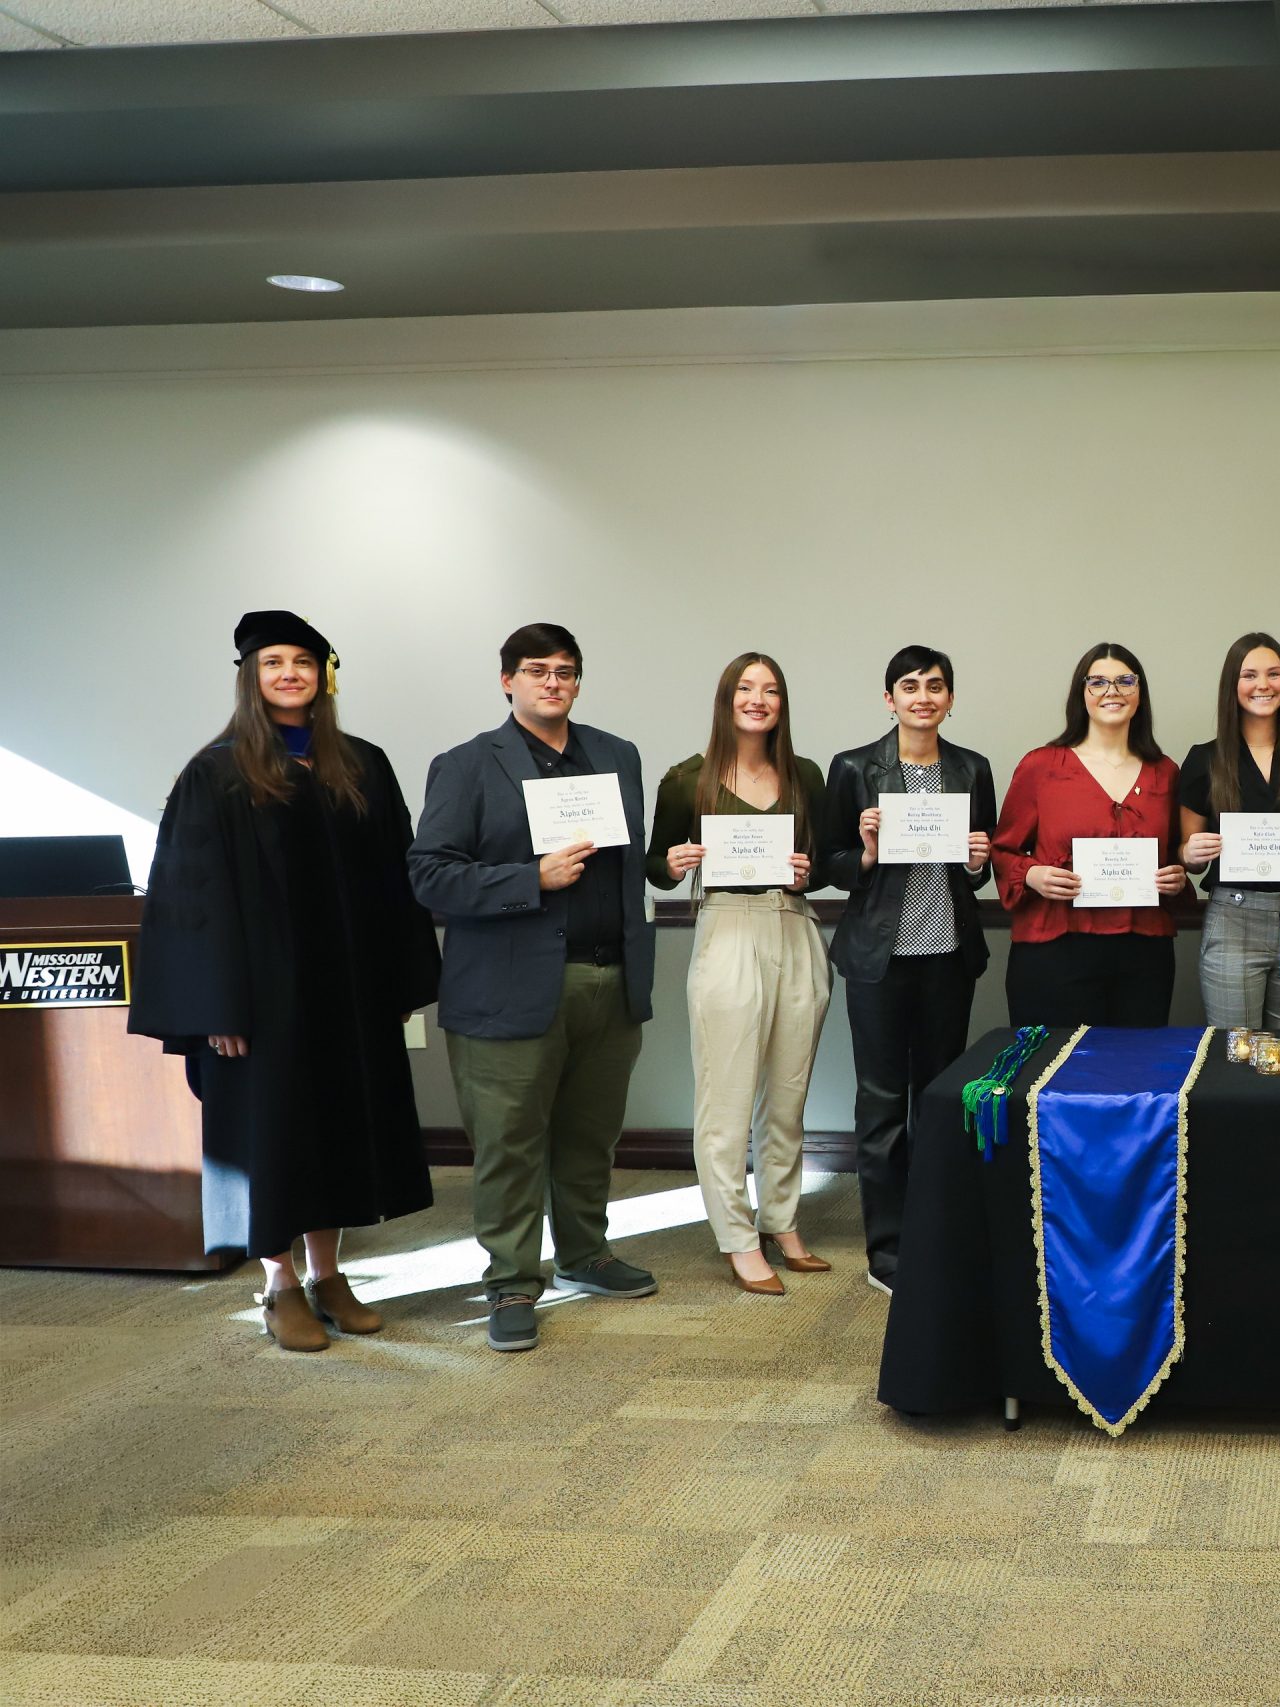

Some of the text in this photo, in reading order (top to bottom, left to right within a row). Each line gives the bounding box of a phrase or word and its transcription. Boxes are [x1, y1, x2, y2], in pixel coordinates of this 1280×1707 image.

[560, 808, 594, 818] Alpha Chi
[908, 824, 928, 832] Alpha
[1248, 843, 1268, 851] Alpha
[1101, 868, 1120, 876] Alpha
[31, 953, 103, 966] MISSOURI
[20, 987, 116, 1000] UNIVERSITY
